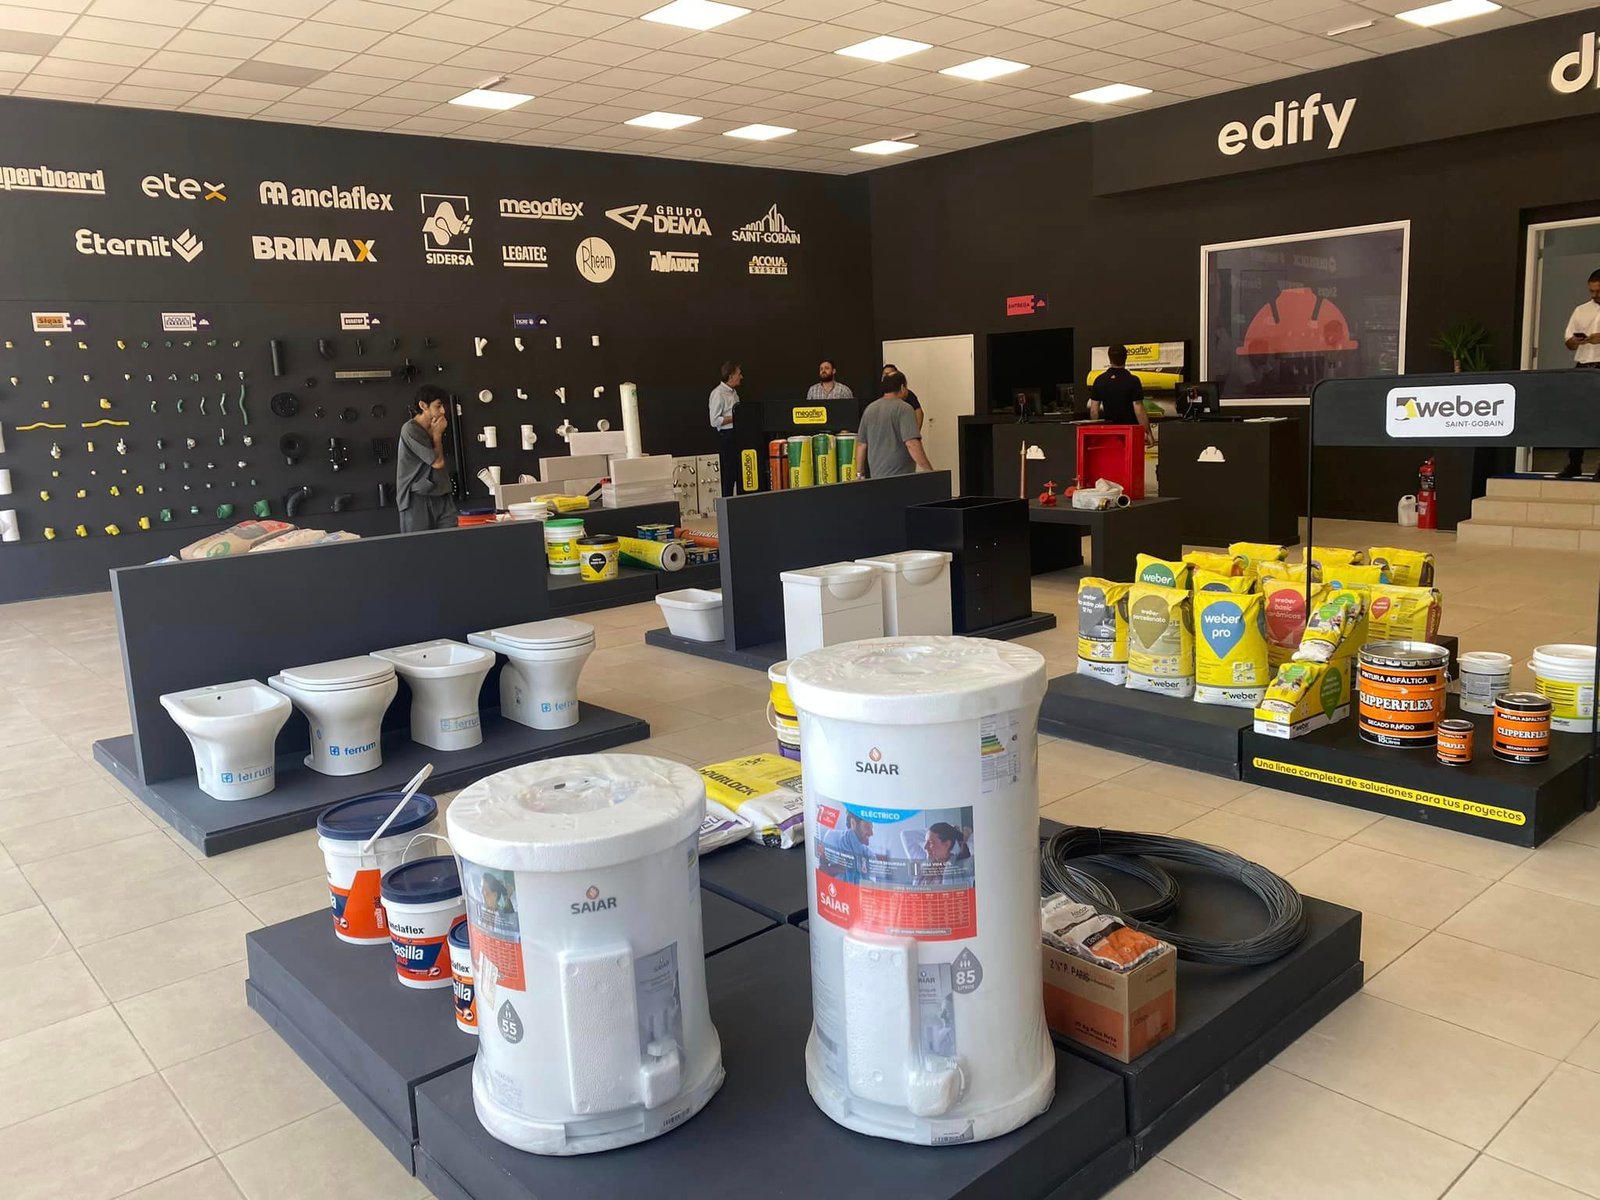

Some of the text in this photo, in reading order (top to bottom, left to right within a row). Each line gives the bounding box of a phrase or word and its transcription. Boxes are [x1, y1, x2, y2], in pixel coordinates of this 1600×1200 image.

[1217, 92, 1357, 156] edify
[141, 173, 227, 202] etex
[500, 197, 584, 220] megaflex
[656, 205, 702, 217] GRUPO
[654, 215, 712, 236] DEMA
[75, 229, 172, 257] Eternit
[732, 230, 800, 244] SAINT-GOBAIN
[252, 236, 377, 263] BRIMAX
[502, 246, 547, 263] LEGATEC
[581, 239, 613, 274] Rheem
[426, 253, 474, 267] SIDERSA
[752, 255, 785, 267] ACQUA
[1126, 346, 1152, 356] egaflex
[1415, 395, 1504, 418] weber
[1445, 419, 1504, 428] SAINT-GOBAIN
[1143, 571, 1173, 587] weber
[1275, 597, 1297, 605] weber
[1275, 604, 1293, 612] basic
[1204, 614, 1241, 624] weber
[1211, 629, 1231, 639] pro
[1094, 665, 1114, 673] weber
[1154, 679, 1180, 688] weber
[1230, 692, 1257, 700] weber
[1360, 691, 1434, 711] CLIPPERFLEX
[555, 700, 578, 712] ferru
[1367, 719, 1390, 728] SECADO
[1378, 735, 1386, 744] 18
[1497, 726, 1549, 739] CLIPPERFLEX
[344, 741, 376, 756] ferrum
[856, 761, 900, 776] SAIAR
[1256, 759, 1274, 770] Una
[1299, 768, 1343, 785] completa
[1345, 777, 1358, 788] de
[1360, 780, 1413, 799] soluciones
[1415, 792, 1441, 805] para
[1443, 798, 1461, 809] tus
[1463, 802, 1522, 822] proyectos
[571, 896, 617, 915] SAIAR
[820, 892, 850, 915] SAIAR
[918, 976, 936, 984] AIAR
[956, 969, 976, 986] 85
[502, 1018, 518, 1036] 55
